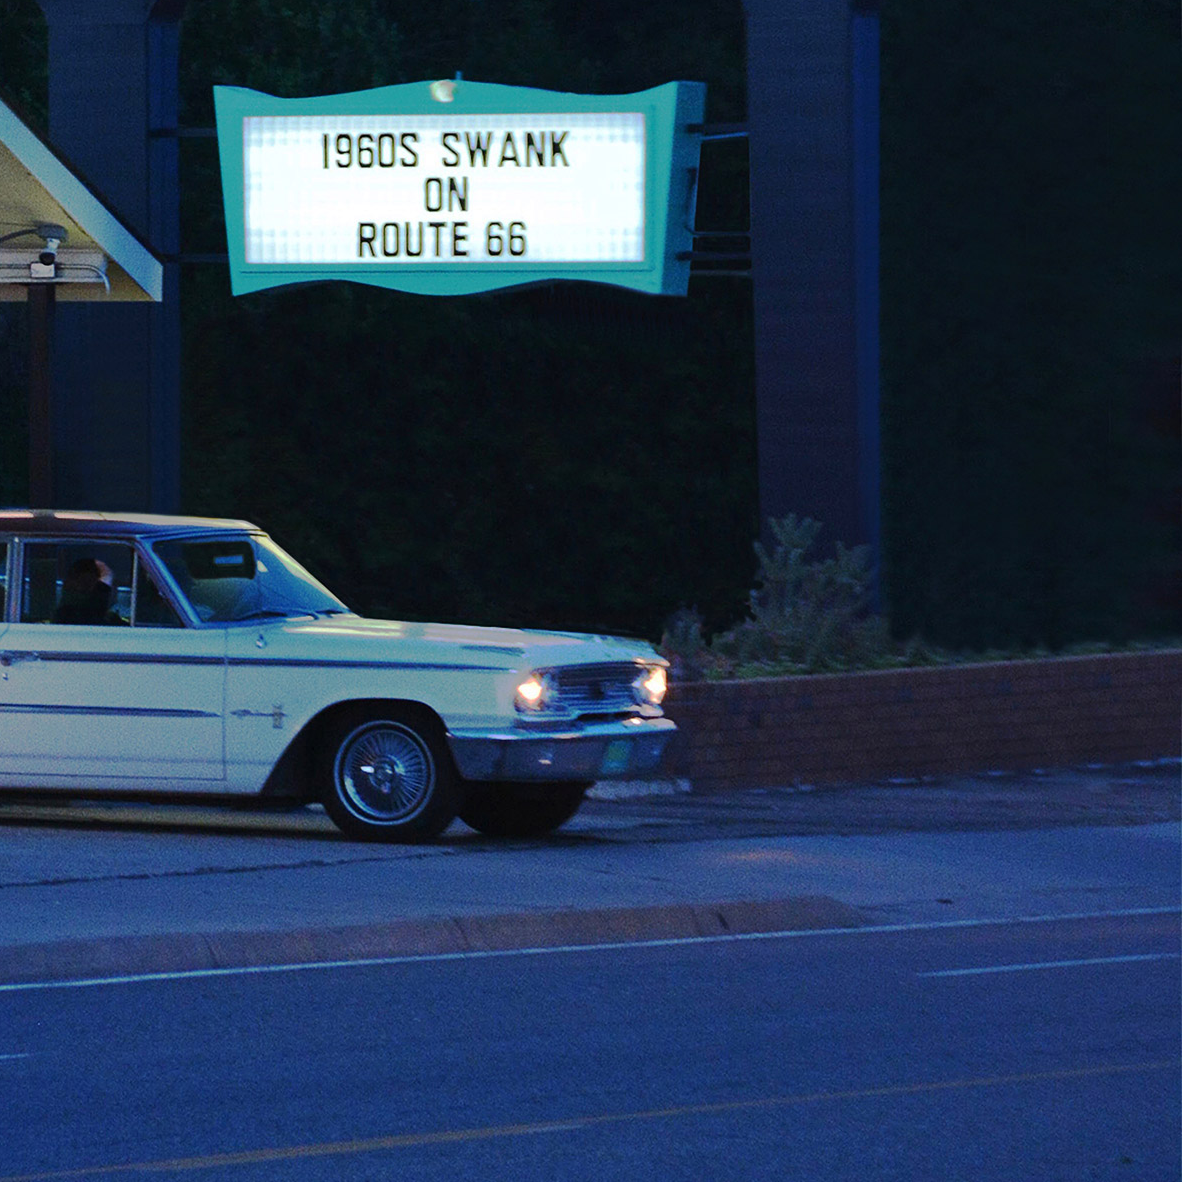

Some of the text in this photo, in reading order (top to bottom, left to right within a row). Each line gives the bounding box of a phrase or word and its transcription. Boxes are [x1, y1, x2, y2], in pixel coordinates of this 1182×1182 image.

[322, 130, 571, 169] 1960S SWANK
[424, 176, 469, 213] ON
[358, 221, 528, 258] ROUTE 66
